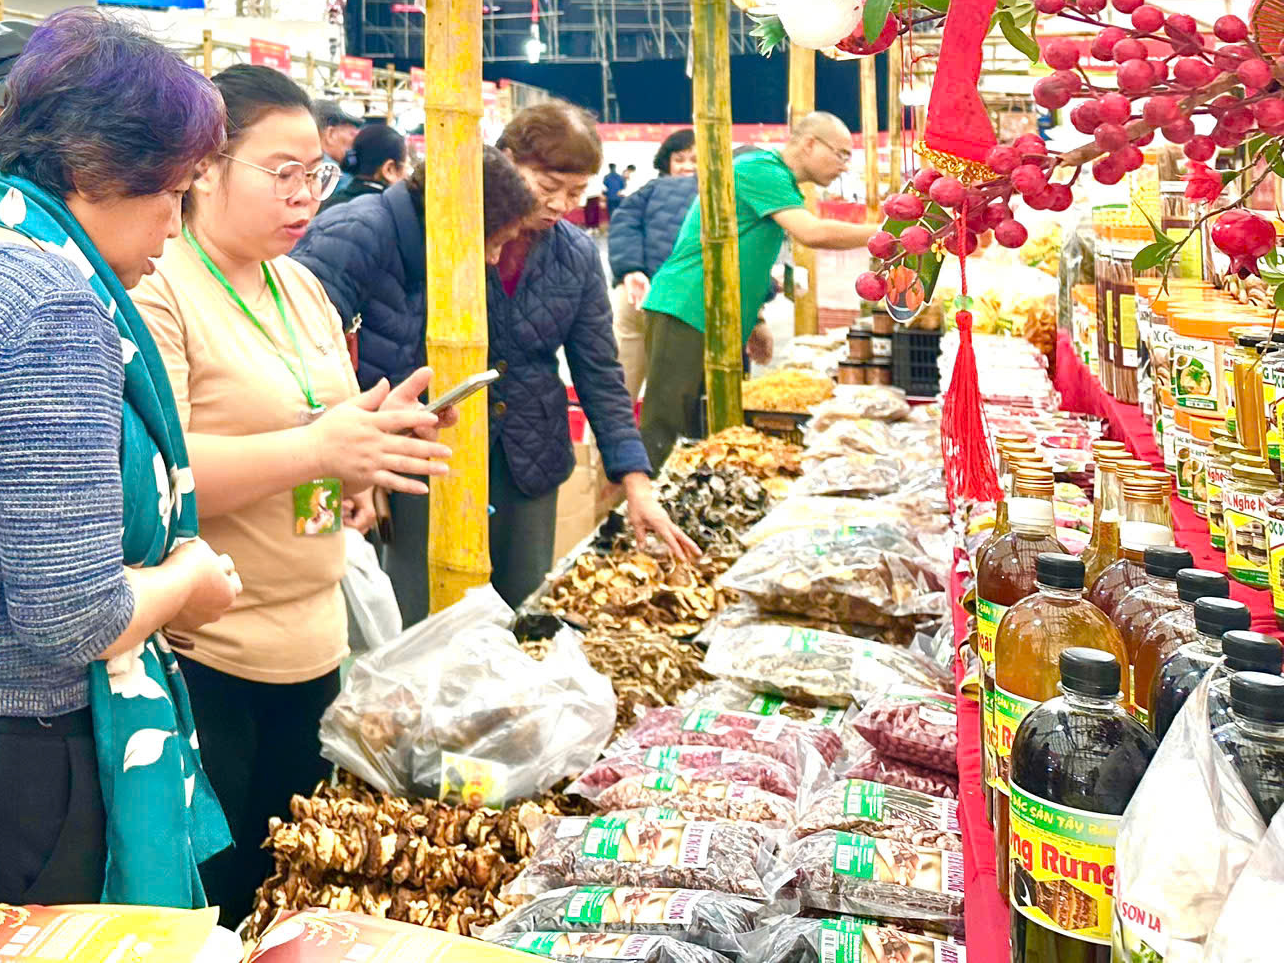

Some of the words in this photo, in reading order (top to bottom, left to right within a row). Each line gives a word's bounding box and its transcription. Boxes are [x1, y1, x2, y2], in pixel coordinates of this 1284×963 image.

[1029, 804, 1054, 825] SẢN
[1056, 816, 1084, 834] TÂY
[1147, 912, 1162, 934] LA
